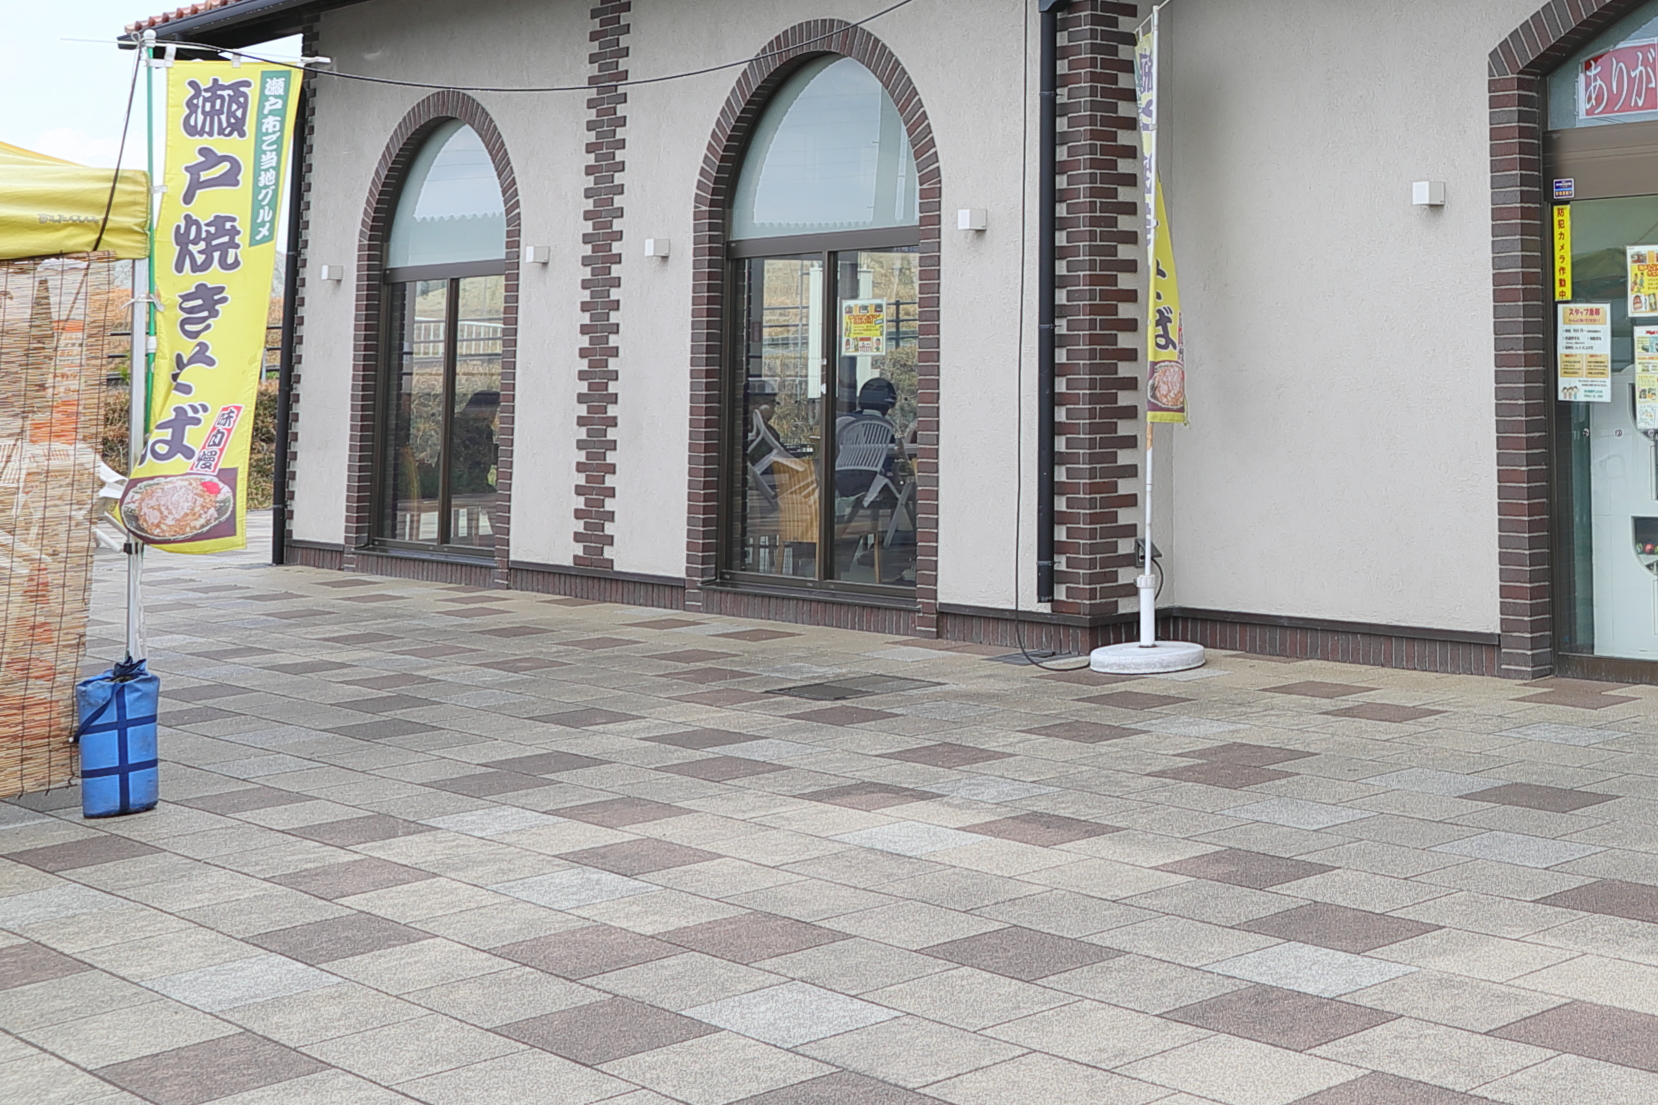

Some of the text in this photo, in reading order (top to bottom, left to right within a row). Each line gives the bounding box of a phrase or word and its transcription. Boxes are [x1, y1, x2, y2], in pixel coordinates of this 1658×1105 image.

[254, 77, 287, 241] 瀬戸市ご当地グルメ
[138, 76, 253, 467] 瀬戸焼きそば
[1556, 207, 1567, 300] 防犯カメラ作動中
